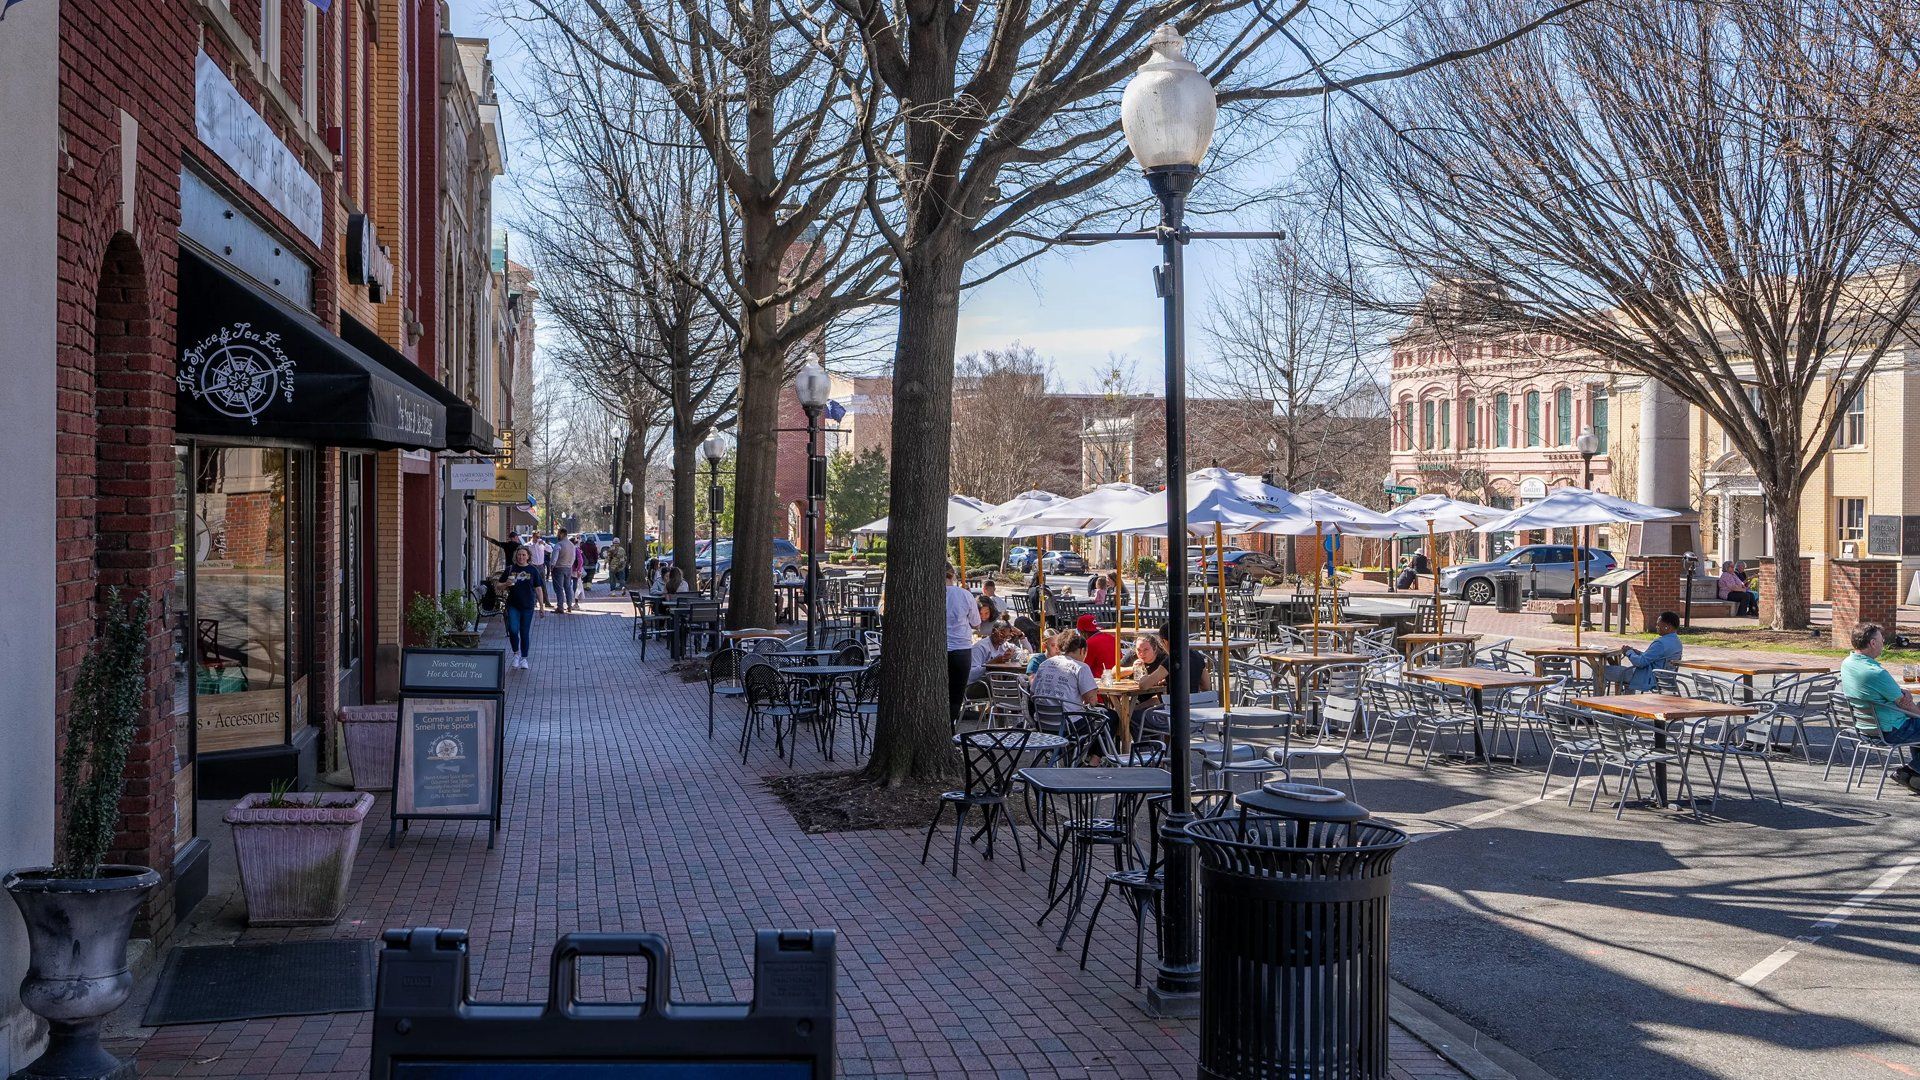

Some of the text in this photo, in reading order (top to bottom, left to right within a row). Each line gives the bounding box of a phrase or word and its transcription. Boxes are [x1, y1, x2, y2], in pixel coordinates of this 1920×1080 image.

[228, 91, 245, 153] The
[176, 322, 297, 400] The Spice & Tea Exchange
[450, 660, 478, 670] Serving
[442, 670, 449, 678] &
[451, 670, 468, 678] Cold
[215, 708, 280, 729] Accessories
[455, 714, 469, 722] and
[415, 721, 477, 731] Smell the Spices!
